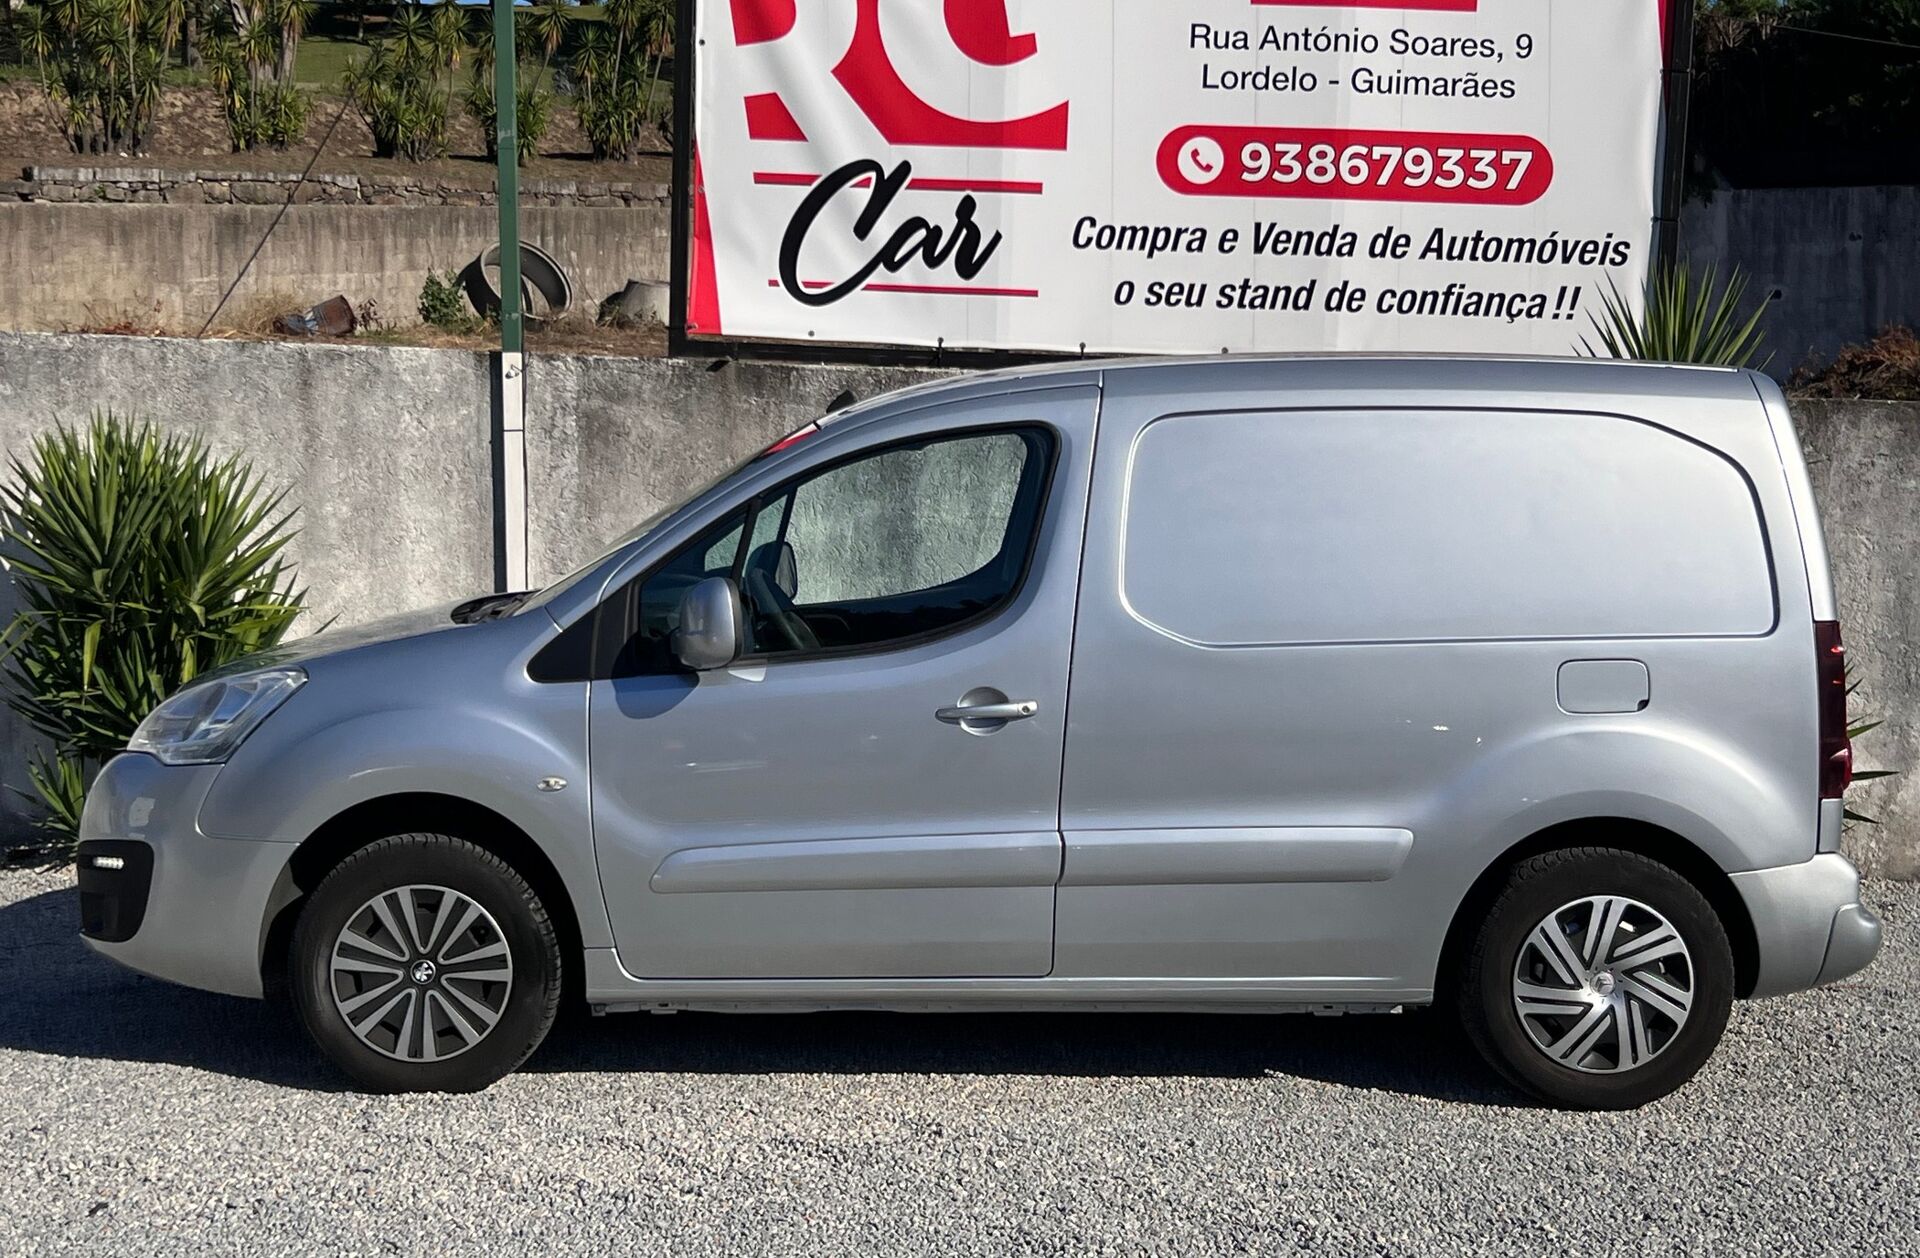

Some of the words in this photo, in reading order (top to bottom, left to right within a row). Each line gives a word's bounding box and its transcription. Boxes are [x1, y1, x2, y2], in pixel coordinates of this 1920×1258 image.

[1191, 24, 1249, 50] Rua
[1259, 26, 1378, 53] António
[1390, 29, 1502, 63] Soares,
[1516, 34, 1532, 58] 9
[1203, 64, 1317, 91] Lordelo
[1352, 66, 1515, 98] Guimarães
[1241, 142, 1533, 190] 938679337
[778, 159, 1002, 306] Car
[1073, 216, 1205, 258] Compra
[1218, 229, 1238, 254] e
[1254, 222, 1357, 257] Venda
[1369, 226, 1411, 259] de
[1419, 228, 1630, 266] Automóveis
[1115, 281, 1134, 305] o
[1145, 282, 1207, 307] seu
[1216, 278, 1316, 311] stand
[1325, 281, 1366, 312] de
